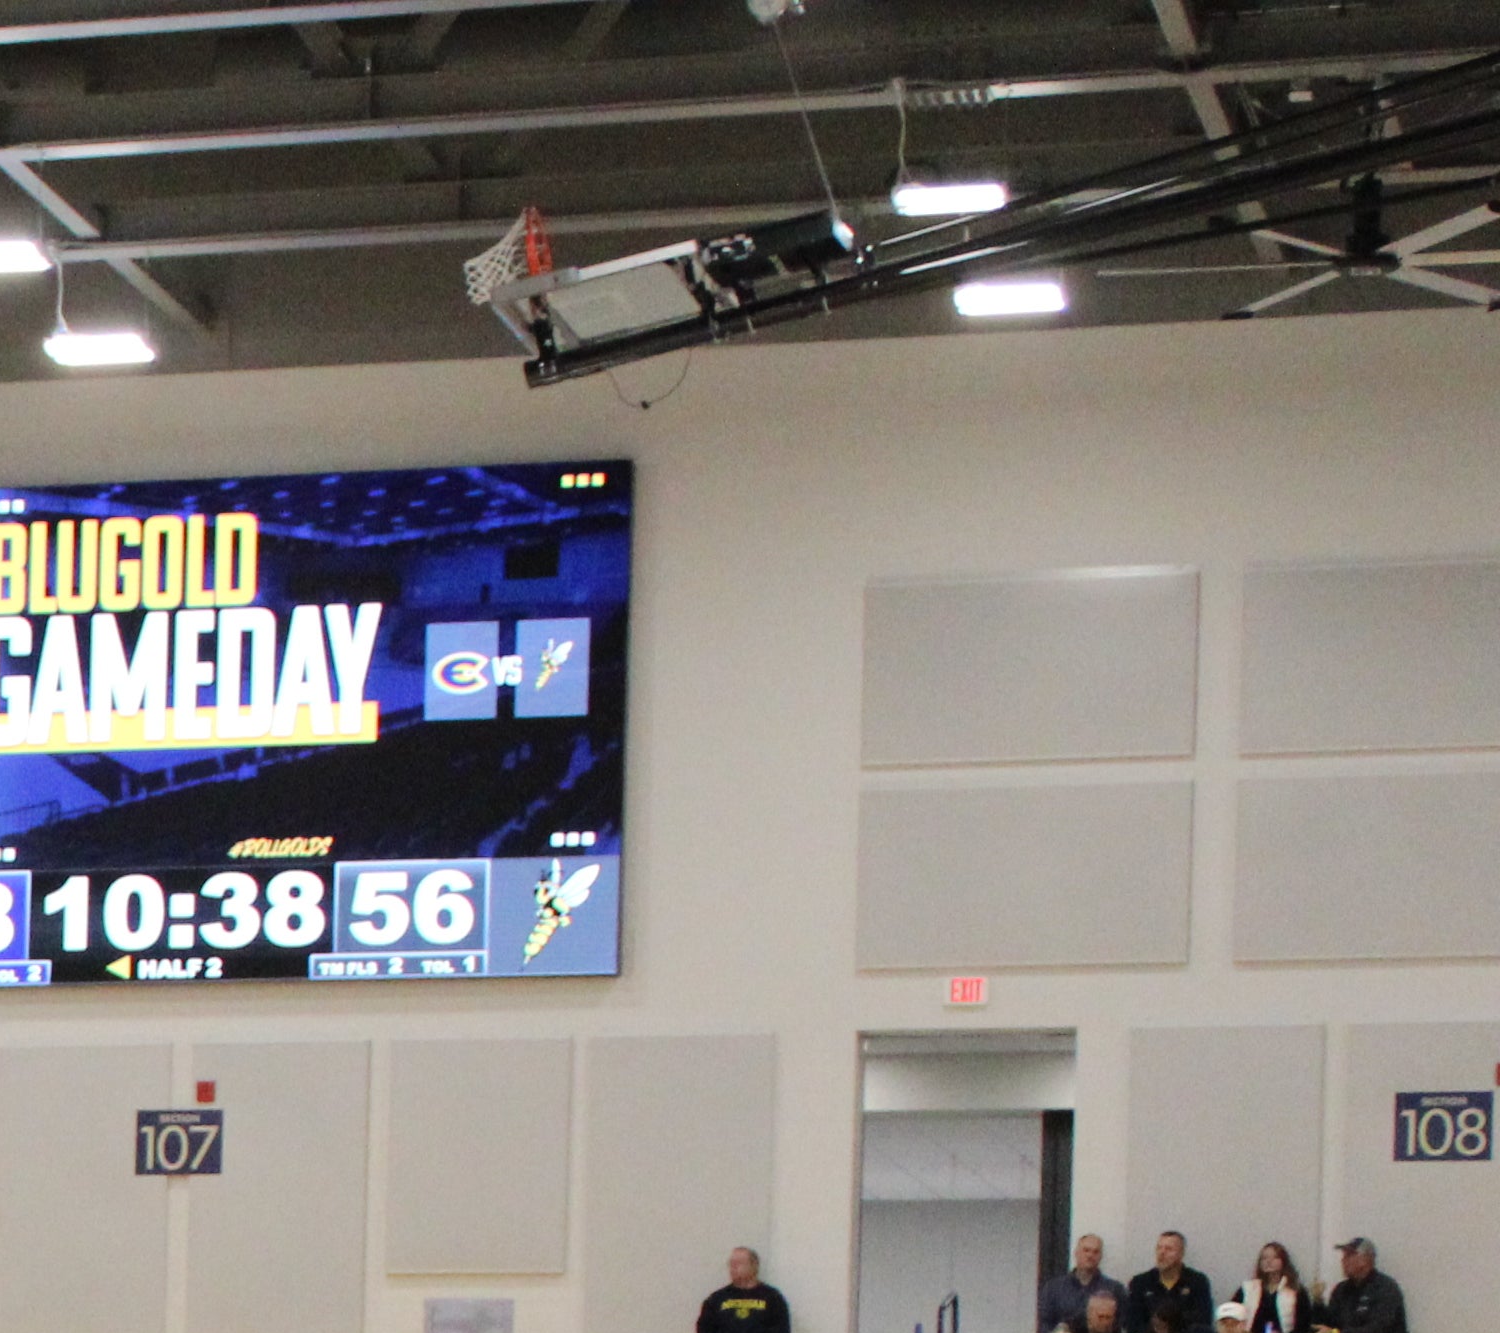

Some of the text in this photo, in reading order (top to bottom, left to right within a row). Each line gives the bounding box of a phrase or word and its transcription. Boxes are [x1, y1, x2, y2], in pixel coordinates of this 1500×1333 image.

[491, 655, 522, 687] VS
[43, 870, 326, 951] 10:38
[348, 868, 474, 946] 56
[26, 965, 42, 982] 2
[136, 957, 223, 979] HALF 2
[388, 956, 404, 974] 2
[463, 955, 476, 973] 1
[951, 977, 985, 1003] EXIT
[141, 1124, 219, 1171] 107
[1400, 1108, 1487, 1156] 108
